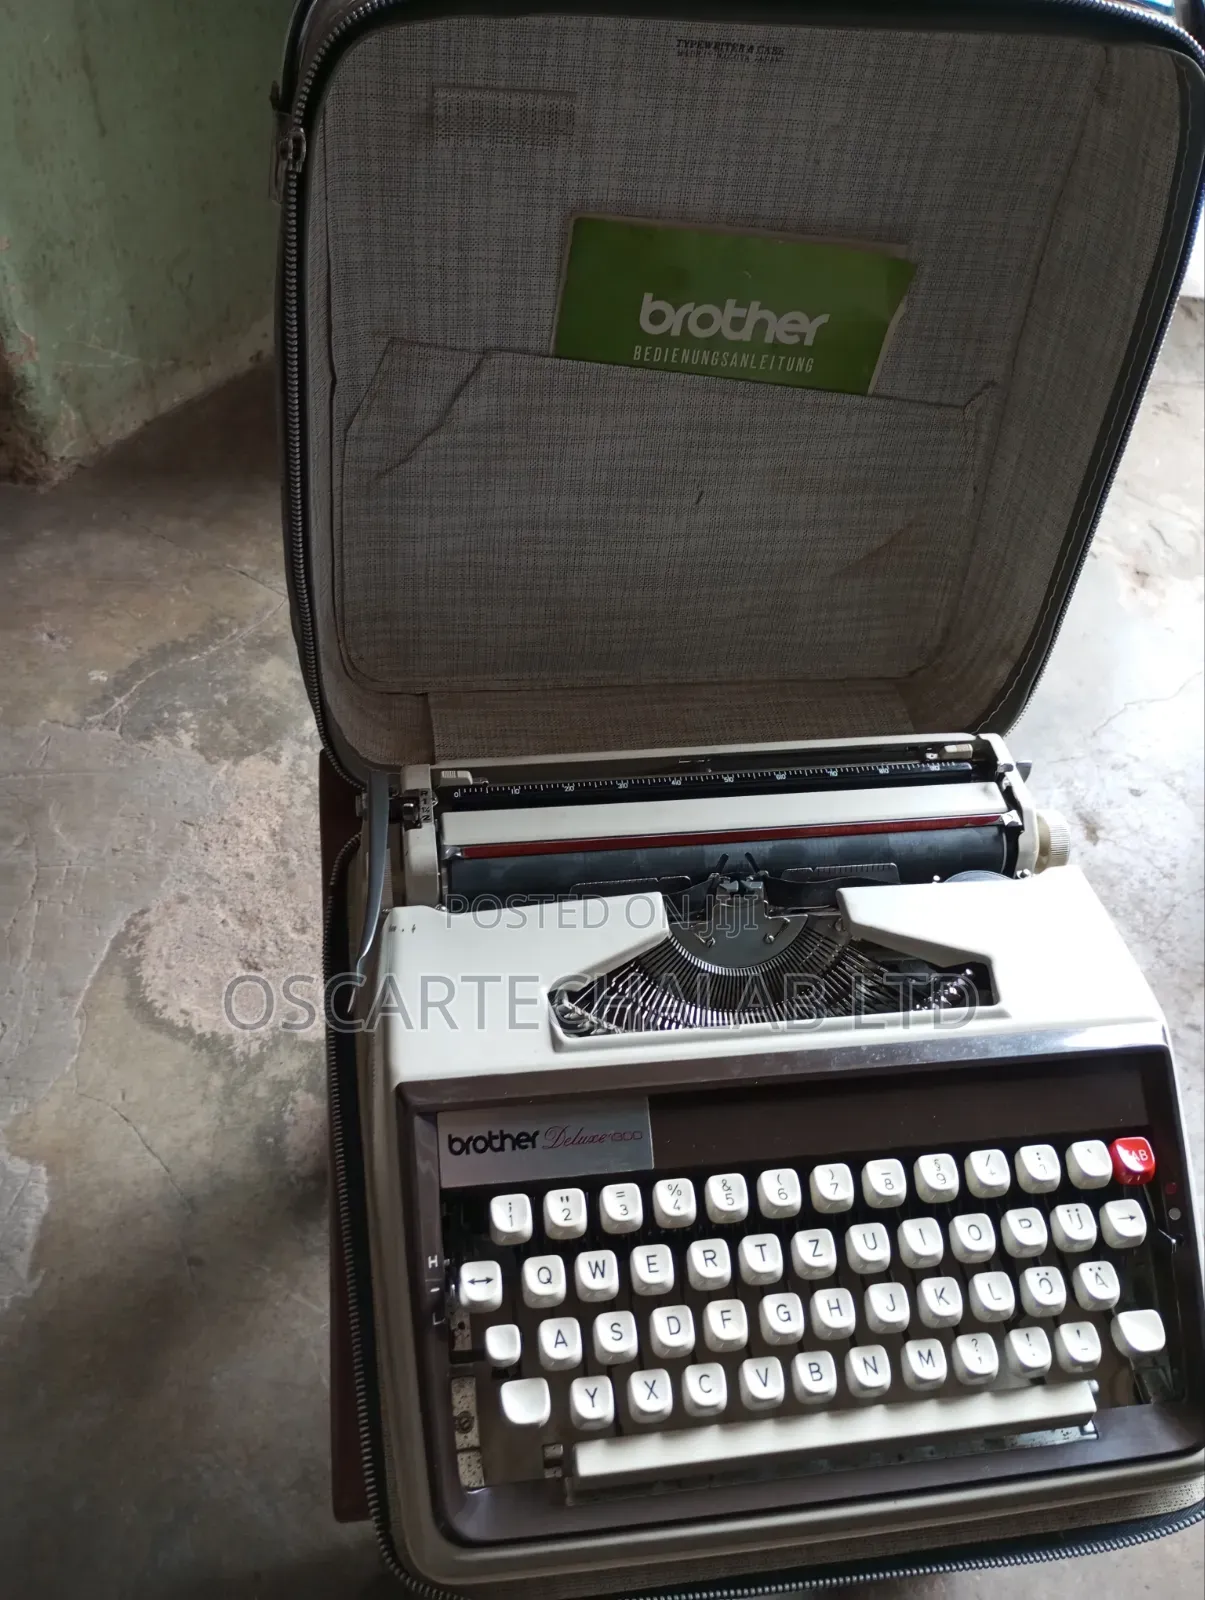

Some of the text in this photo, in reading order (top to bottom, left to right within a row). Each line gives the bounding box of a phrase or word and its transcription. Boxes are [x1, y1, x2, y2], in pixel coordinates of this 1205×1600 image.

[639, 292, 830, 347] brother
[633, 345, 815, 374] BEDIENUNGSANLEITUNG
[448, 1129, 539, 1157] brother
[829, 1182, 839, 1195] 7
[885, 1178, 895, 1191] 8
[936, 1172, 947, 1185] 9
[726, 1193, 735, 1206] 5
[778, 1187, 788, 1201] 6
[561, 1208, 573, 1221] 2
[620, 1203, 630, 1216] 3
[672, 1198, 682, 1212] 4
[863, 1232, 878, 1250] U
[967, 1223, 983, 1242] O
[703, 1248, 718, 1268] R
[754, 1243, 767, 1262] T
[808, 1238, 823, 1258] Z
[428, 1255, 439, 1269] H
[587, 1259, 606, 1280] W
[647, 1254, 660, 1273] E
[537, 1266, 553, 1286] Q
[934, 1287, 950, 1306] K
[988, 1282, 1002, 1301] L
[828, 1297, 843, 1317] H
[886, 1293, 896, 1312] J
[721, 1310, 732, 1329] F
[775, 1303, 792, 1323] G
[611, 1322, 624, 1342] S
[668, 1315, 682, 1336] D
[553, 1328, 569, 1349] A
[862, 1355, 878, 1376] N
[918, 1349, 935, 1369] M
[755, 1367, 769, 1388] V
[808, 1361, 823, 1382] B
[643, 1378, 659, 1401] X
[698, 1373, 713, 1394] C
[584, 1387, 599, 1409] Y
